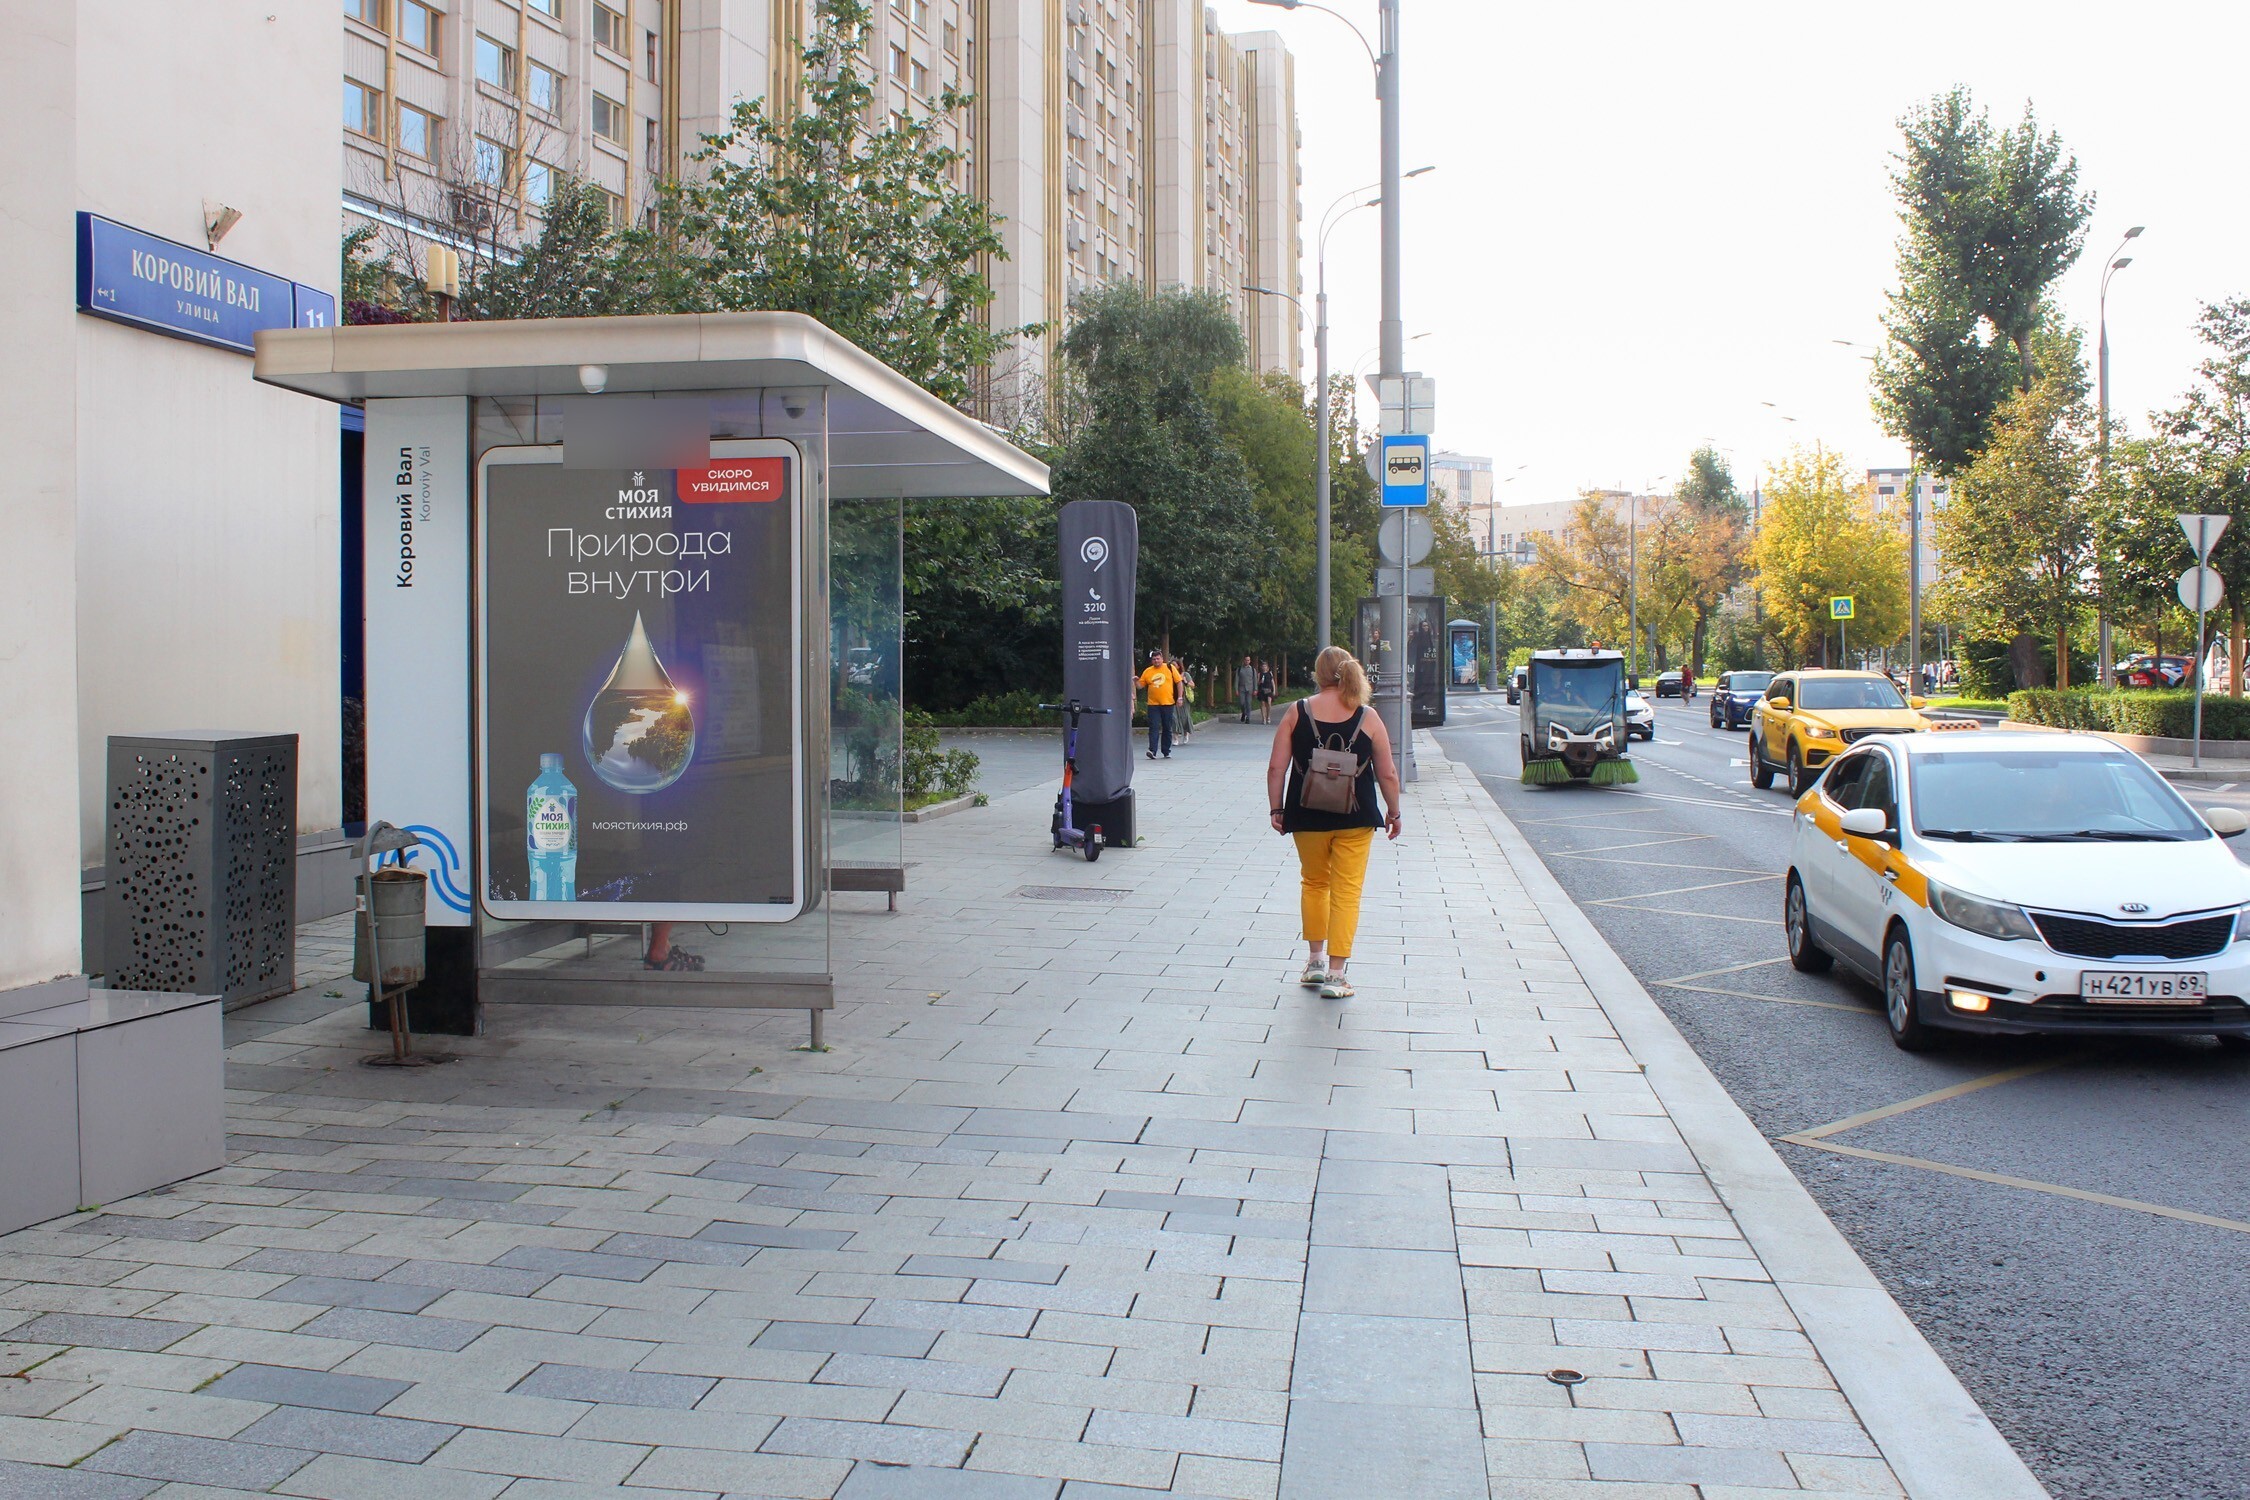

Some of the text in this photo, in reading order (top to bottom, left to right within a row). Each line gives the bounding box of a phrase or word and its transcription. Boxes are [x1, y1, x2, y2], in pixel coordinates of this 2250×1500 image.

[132, 249, 260, 313] КОРОВИЙ ВАЛ
[176, 299, 220, 324] УЛИЦА
[305, 308, 325, 329] 11
[707, 469, 753, 480] СКОРО
[419, 446, 433, 522] Koroviy Val
[691, 481, 770, 494] УВИДИМСЯ
[618, 489, 659, 504] МОЯ
[396, 447, 416, 588] Коровий Вал
[605, 505, 673, 520] СТИХИЯ
[547, 527, 732, 563] Природа
[567, 568, 711, 600] внутри
[1083, 602, 1106, 612] 3210
[541, 812, 563, 822] МОЯ
[535, 822, 570, 830] СТИХИЯ
[592, 819, 688, 832] моястихия.рф
[2179, 976, 2199, 991] 69
